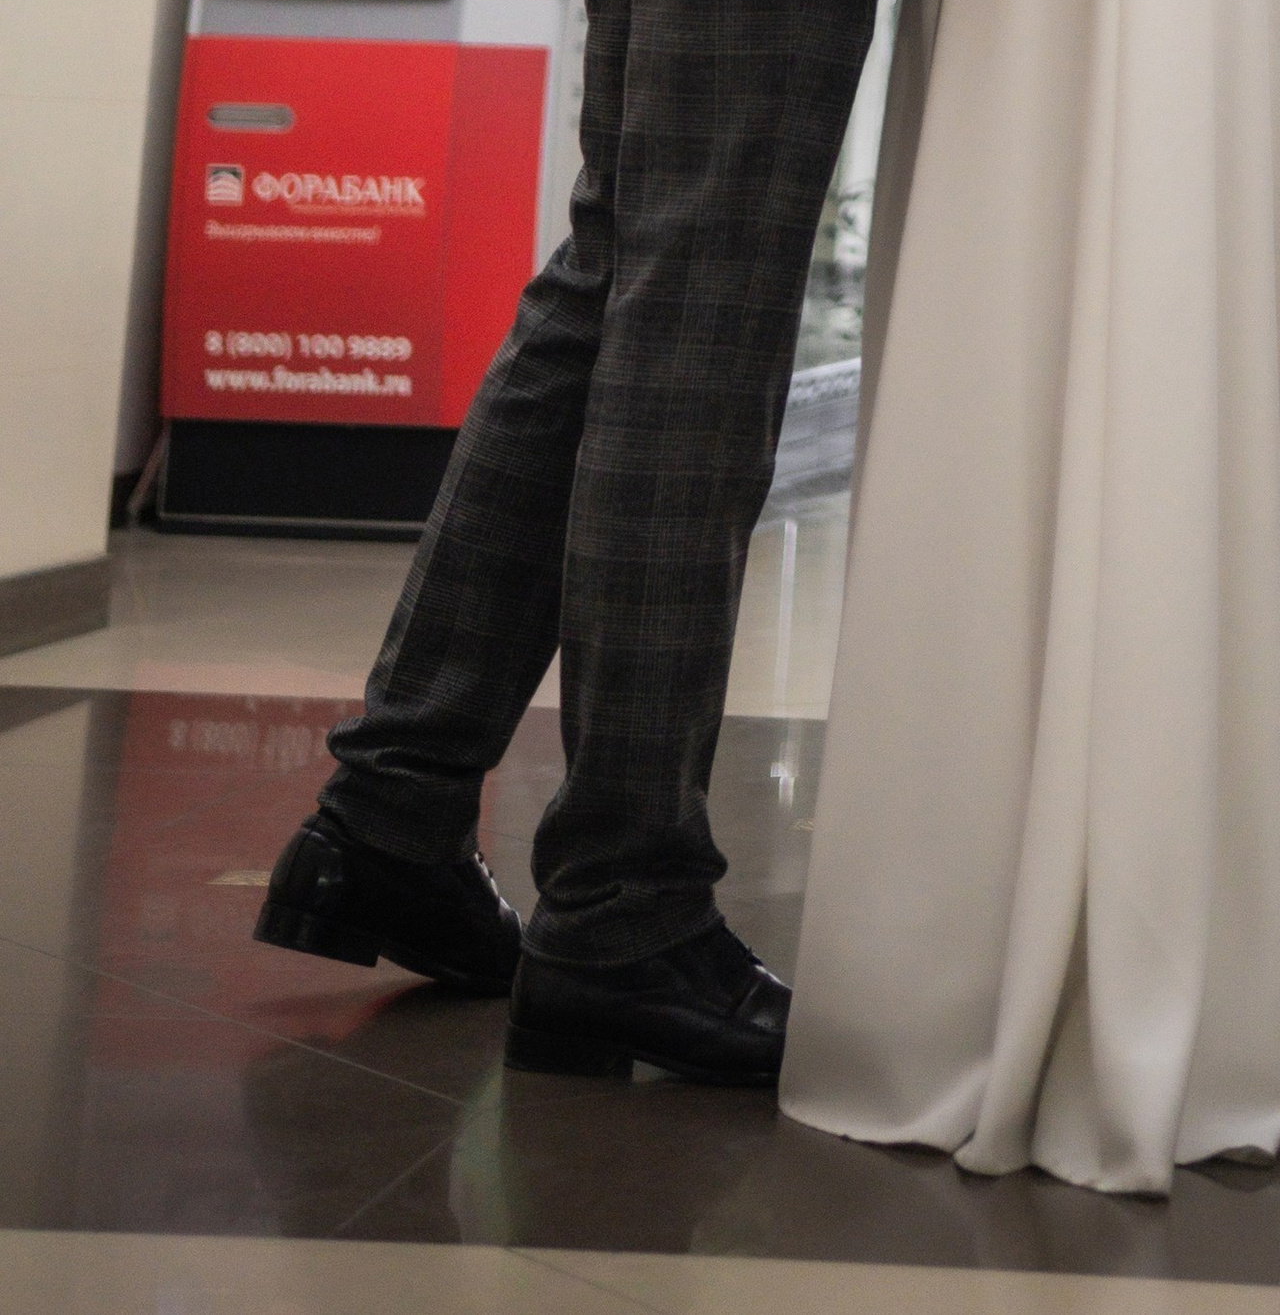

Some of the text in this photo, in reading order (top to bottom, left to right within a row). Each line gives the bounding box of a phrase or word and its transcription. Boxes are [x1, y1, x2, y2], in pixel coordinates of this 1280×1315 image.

[253, 172, 425, 205] ФОРАБАНК
[226, 330, 293, 359] (800)
[297, 334, 345, 359] 100
